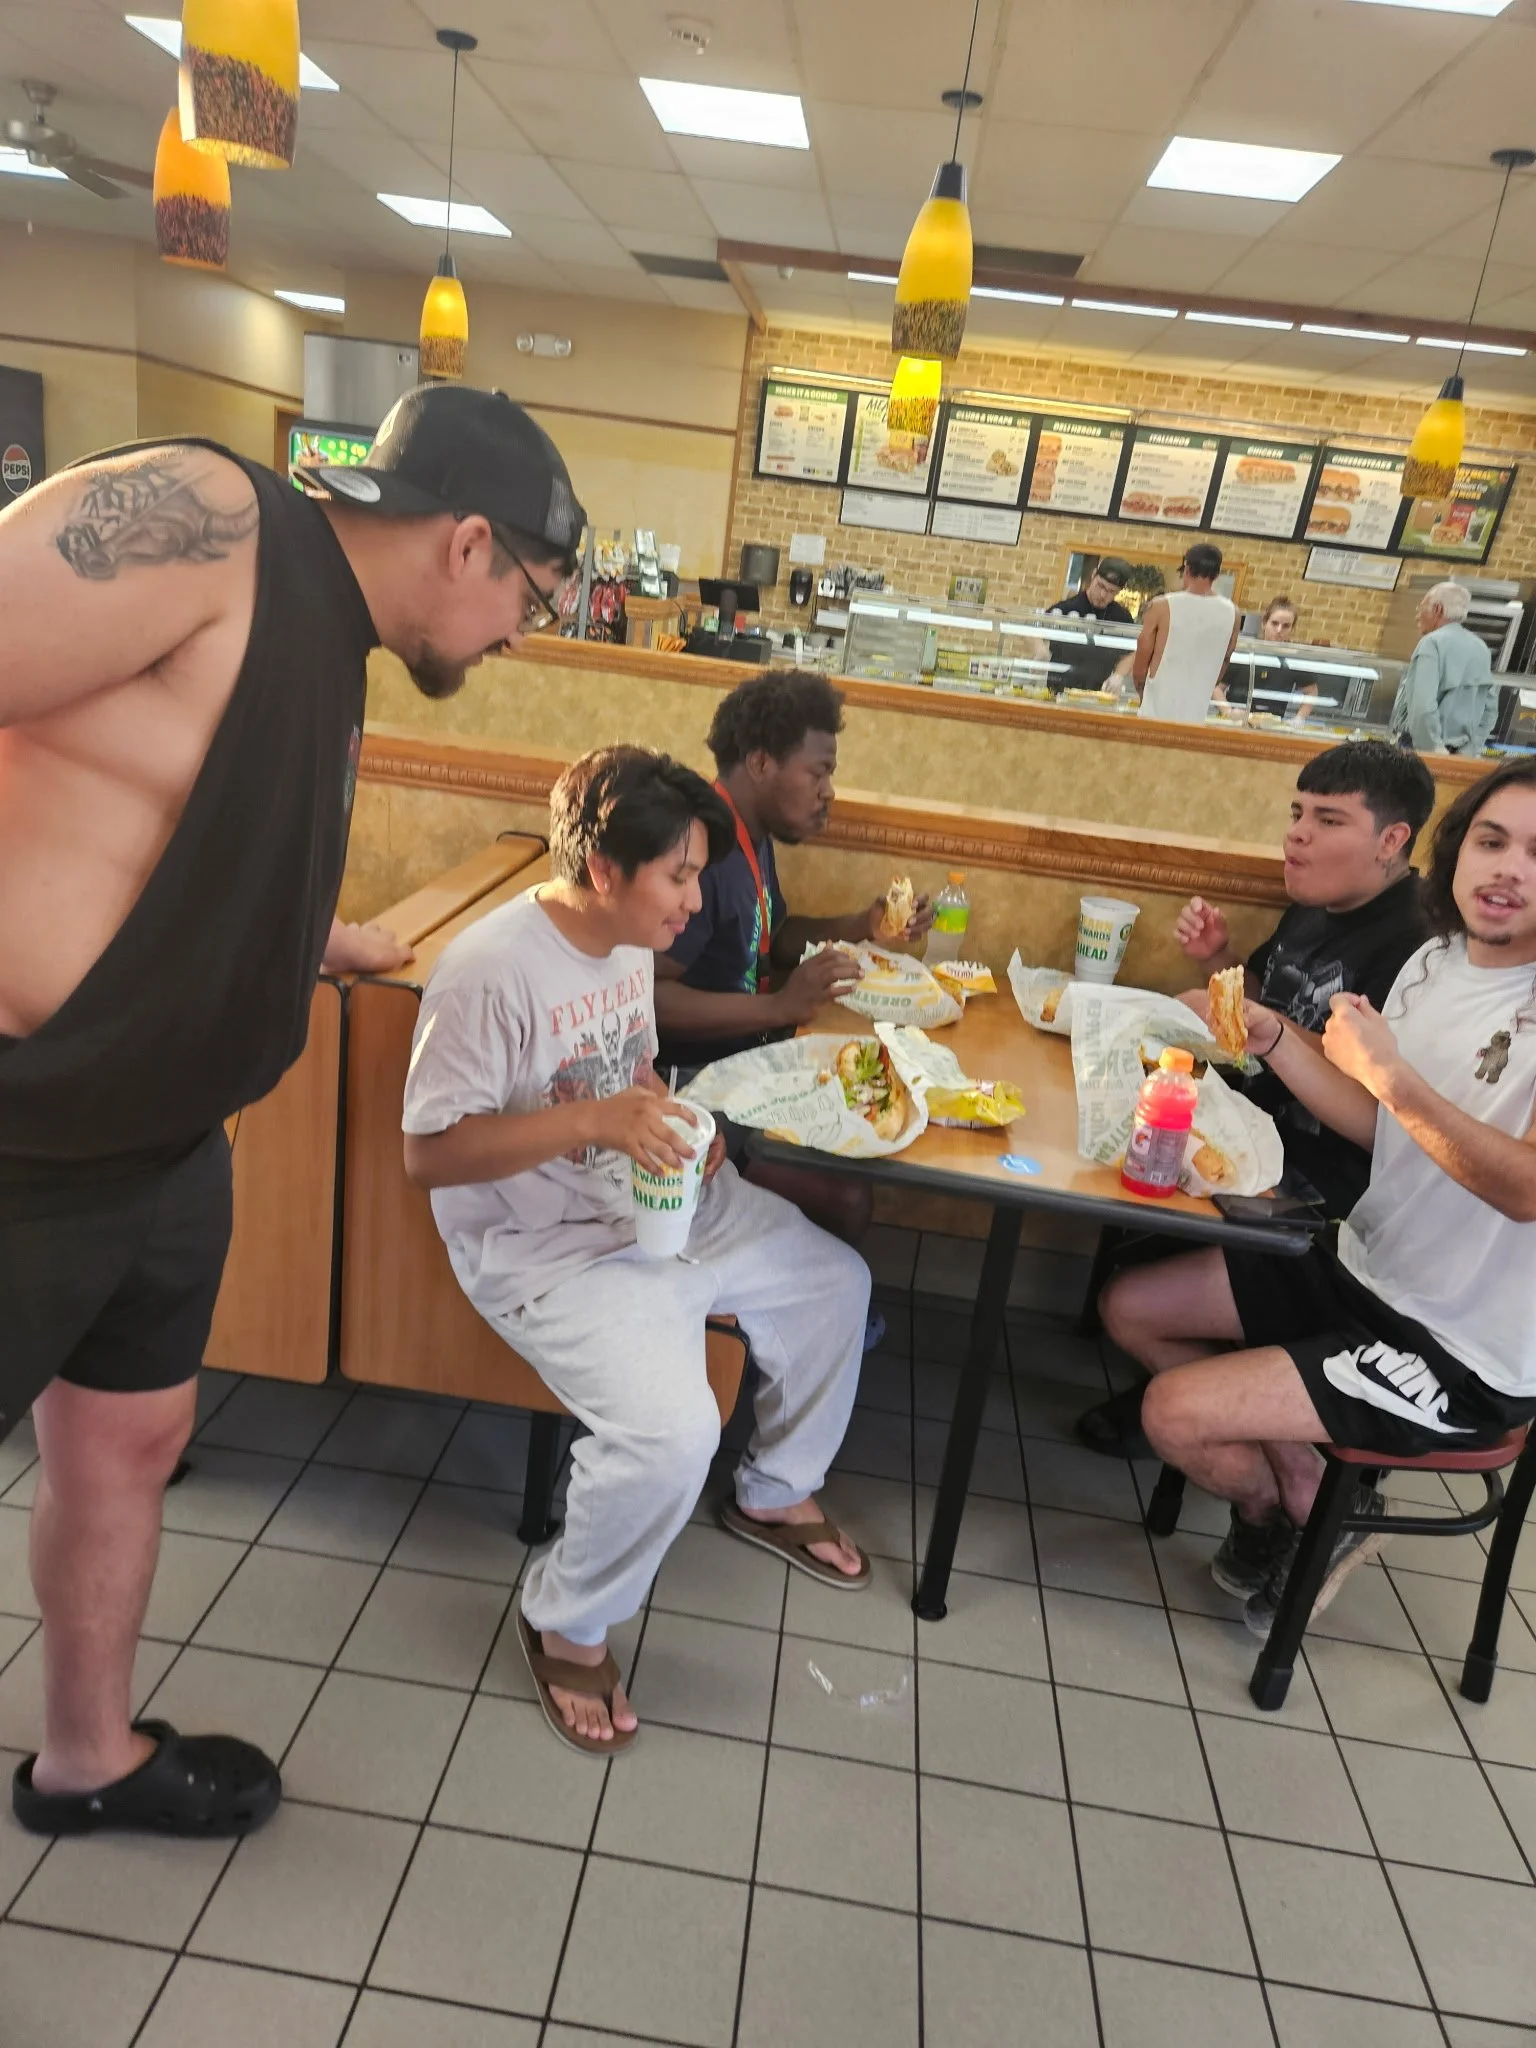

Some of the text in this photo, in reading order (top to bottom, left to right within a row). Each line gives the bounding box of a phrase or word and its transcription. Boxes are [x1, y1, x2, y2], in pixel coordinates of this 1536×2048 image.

[1246, 446, 1284, 459] CHICKEN
[4, 463, 30, 476] PEPSI
[550, 967, 646, 1036] FLYLEAF
